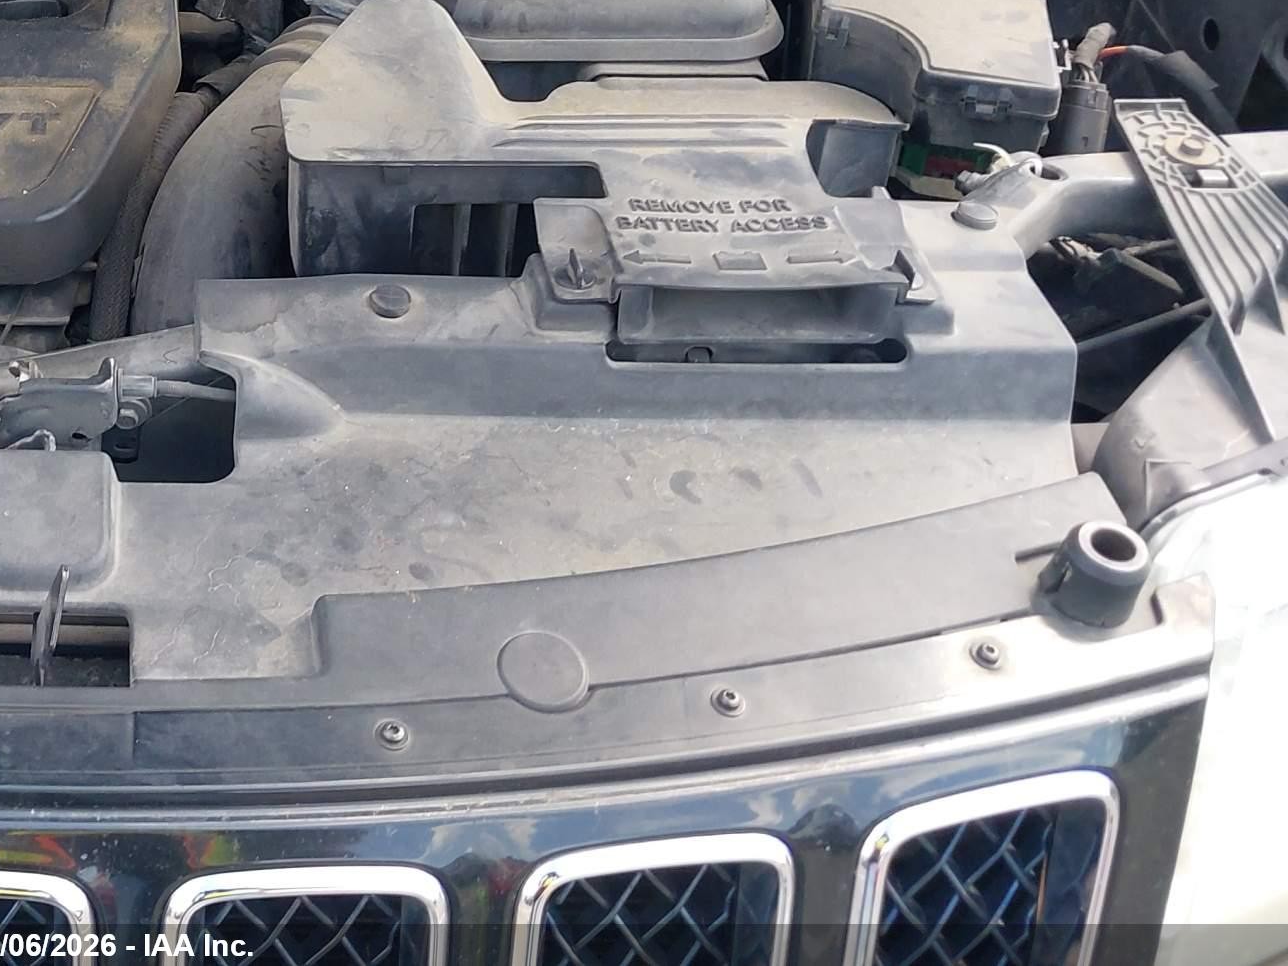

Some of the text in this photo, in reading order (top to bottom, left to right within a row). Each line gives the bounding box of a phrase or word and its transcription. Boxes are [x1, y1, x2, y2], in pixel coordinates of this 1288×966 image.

[627, 198, 793, 214] REMOVE FOR
[616, 216, 829, 234] BATTERY ACCESS
